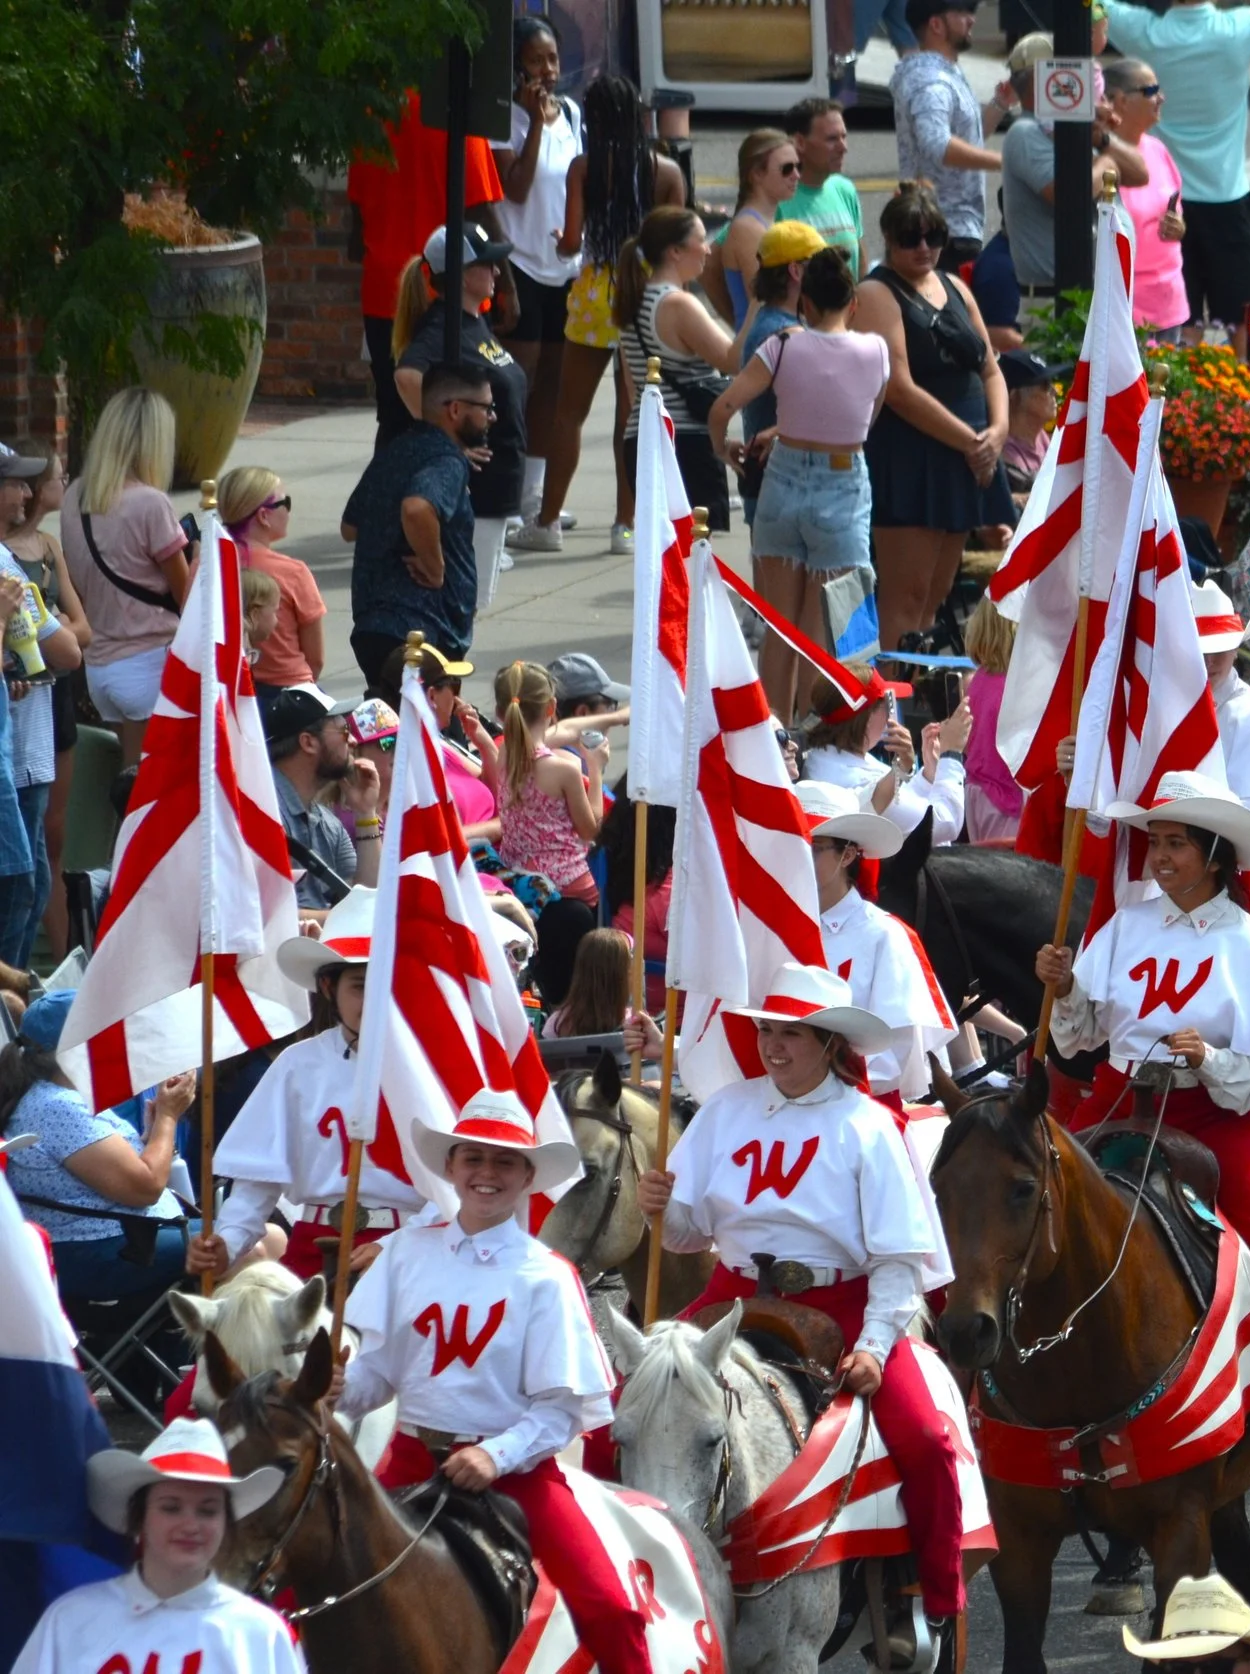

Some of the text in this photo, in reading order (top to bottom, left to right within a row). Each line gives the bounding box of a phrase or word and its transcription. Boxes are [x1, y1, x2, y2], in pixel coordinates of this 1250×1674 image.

[1128, 955, 1215, 1020] W
[731, 1134, 821, 1206] W
[413, 1298, 507, 1378] W
